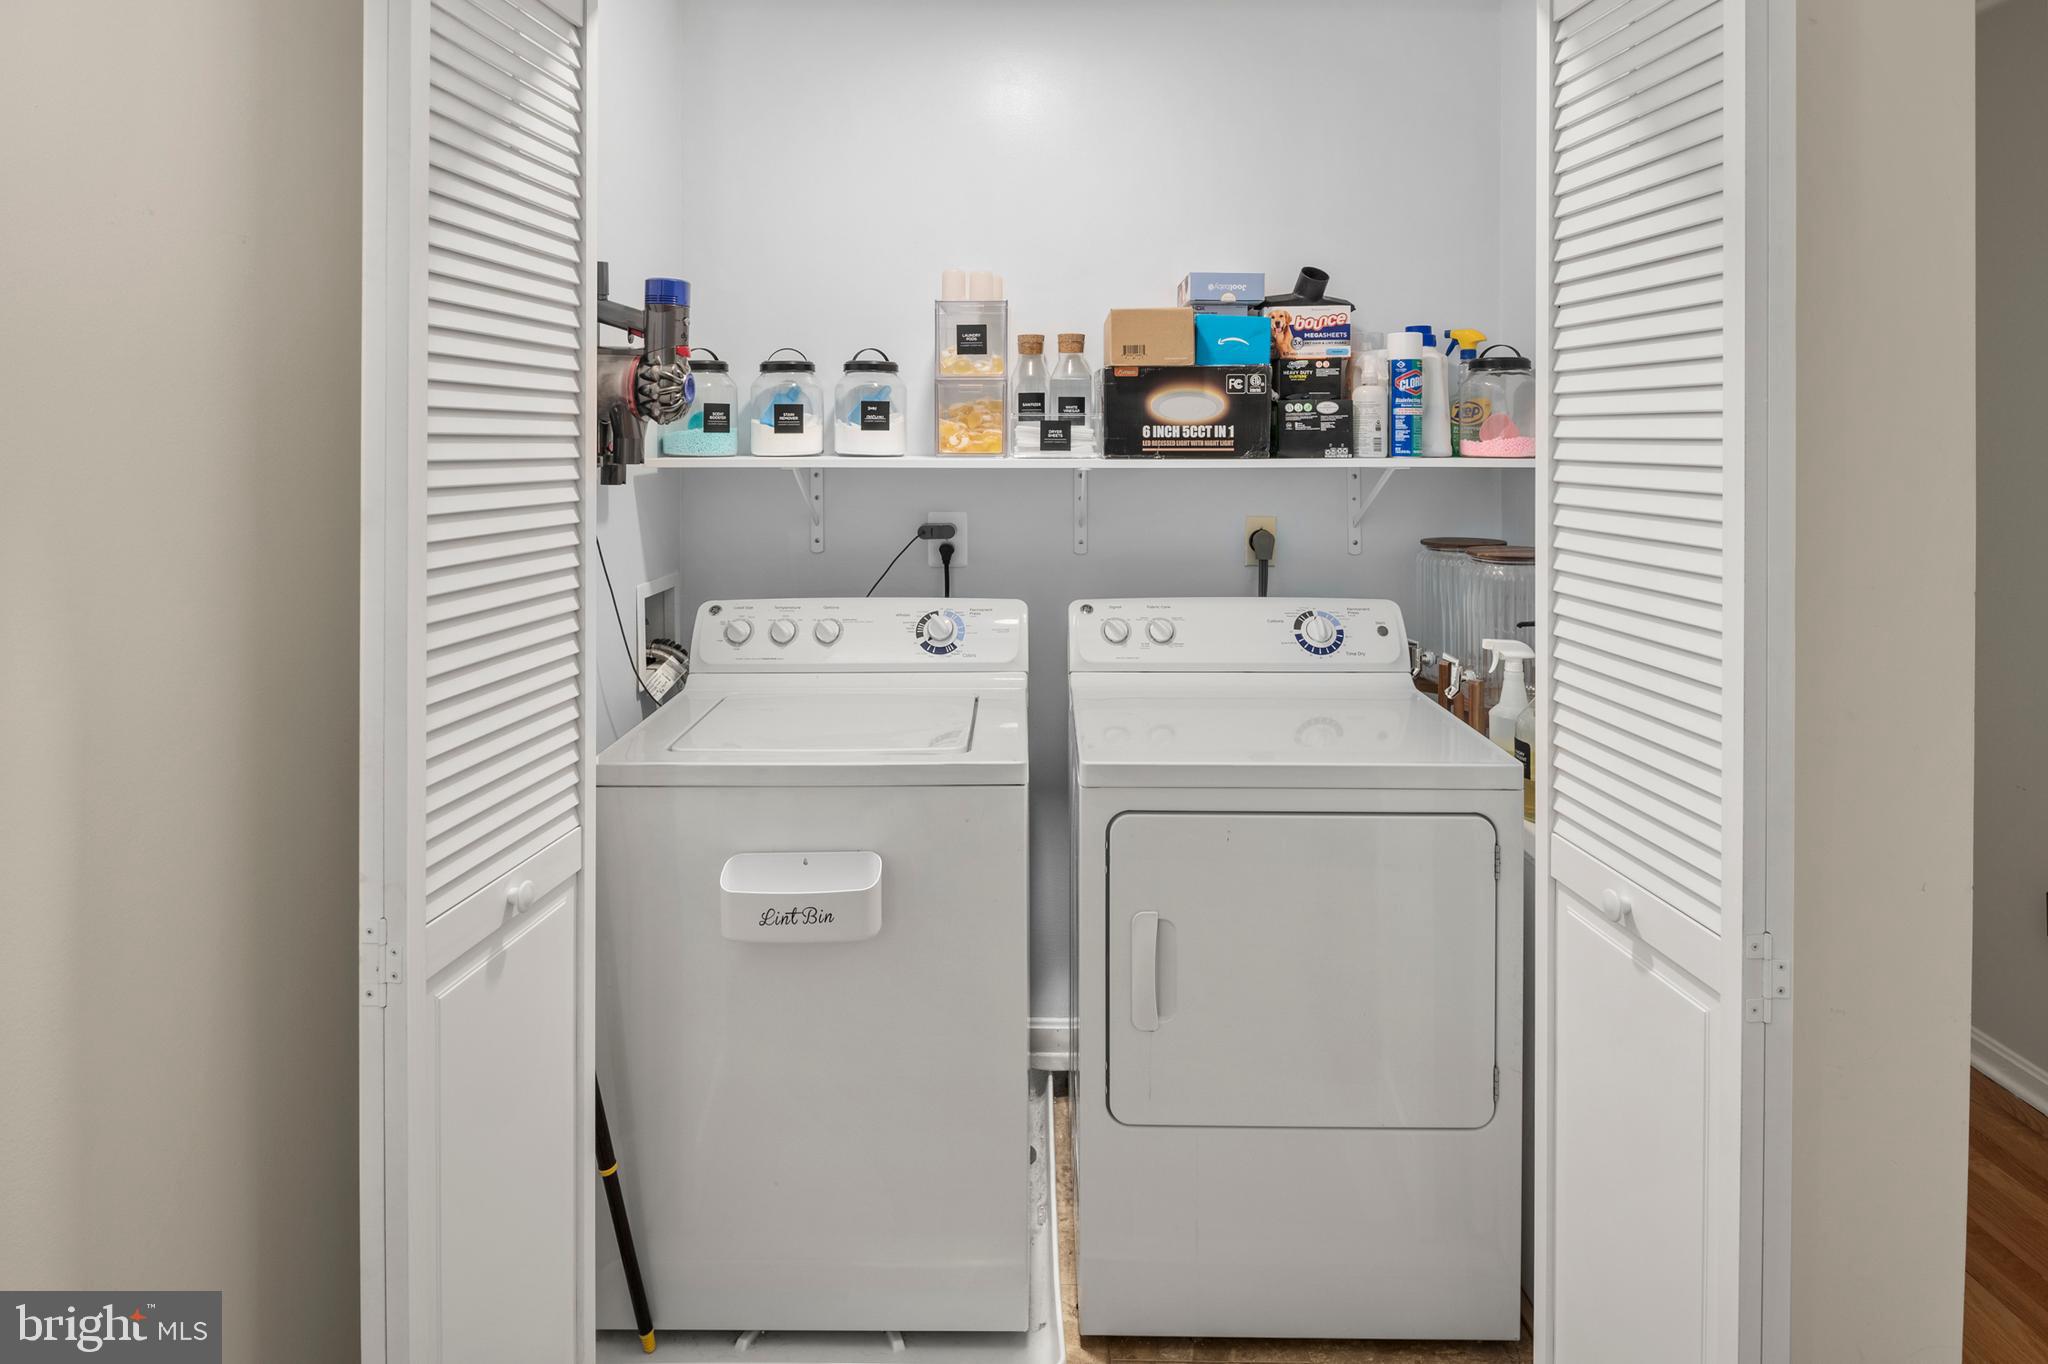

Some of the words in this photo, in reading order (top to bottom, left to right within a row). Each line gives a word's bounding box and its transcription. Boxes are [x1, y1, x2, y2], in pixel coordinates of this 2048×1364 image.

[1294, 313, 1348, 332] bounce
[1142, 425, 1151, 438] 6
[1152, 425, 1180, 438] INCH
[1182, 425, 1213, 438] 5CCT
[1214, 425, 1226, 438] IN
[1228, 425, 1235, 438] 1
[759, 907, 801, 926] Lint
[802, 906, 834, 925] Bin
